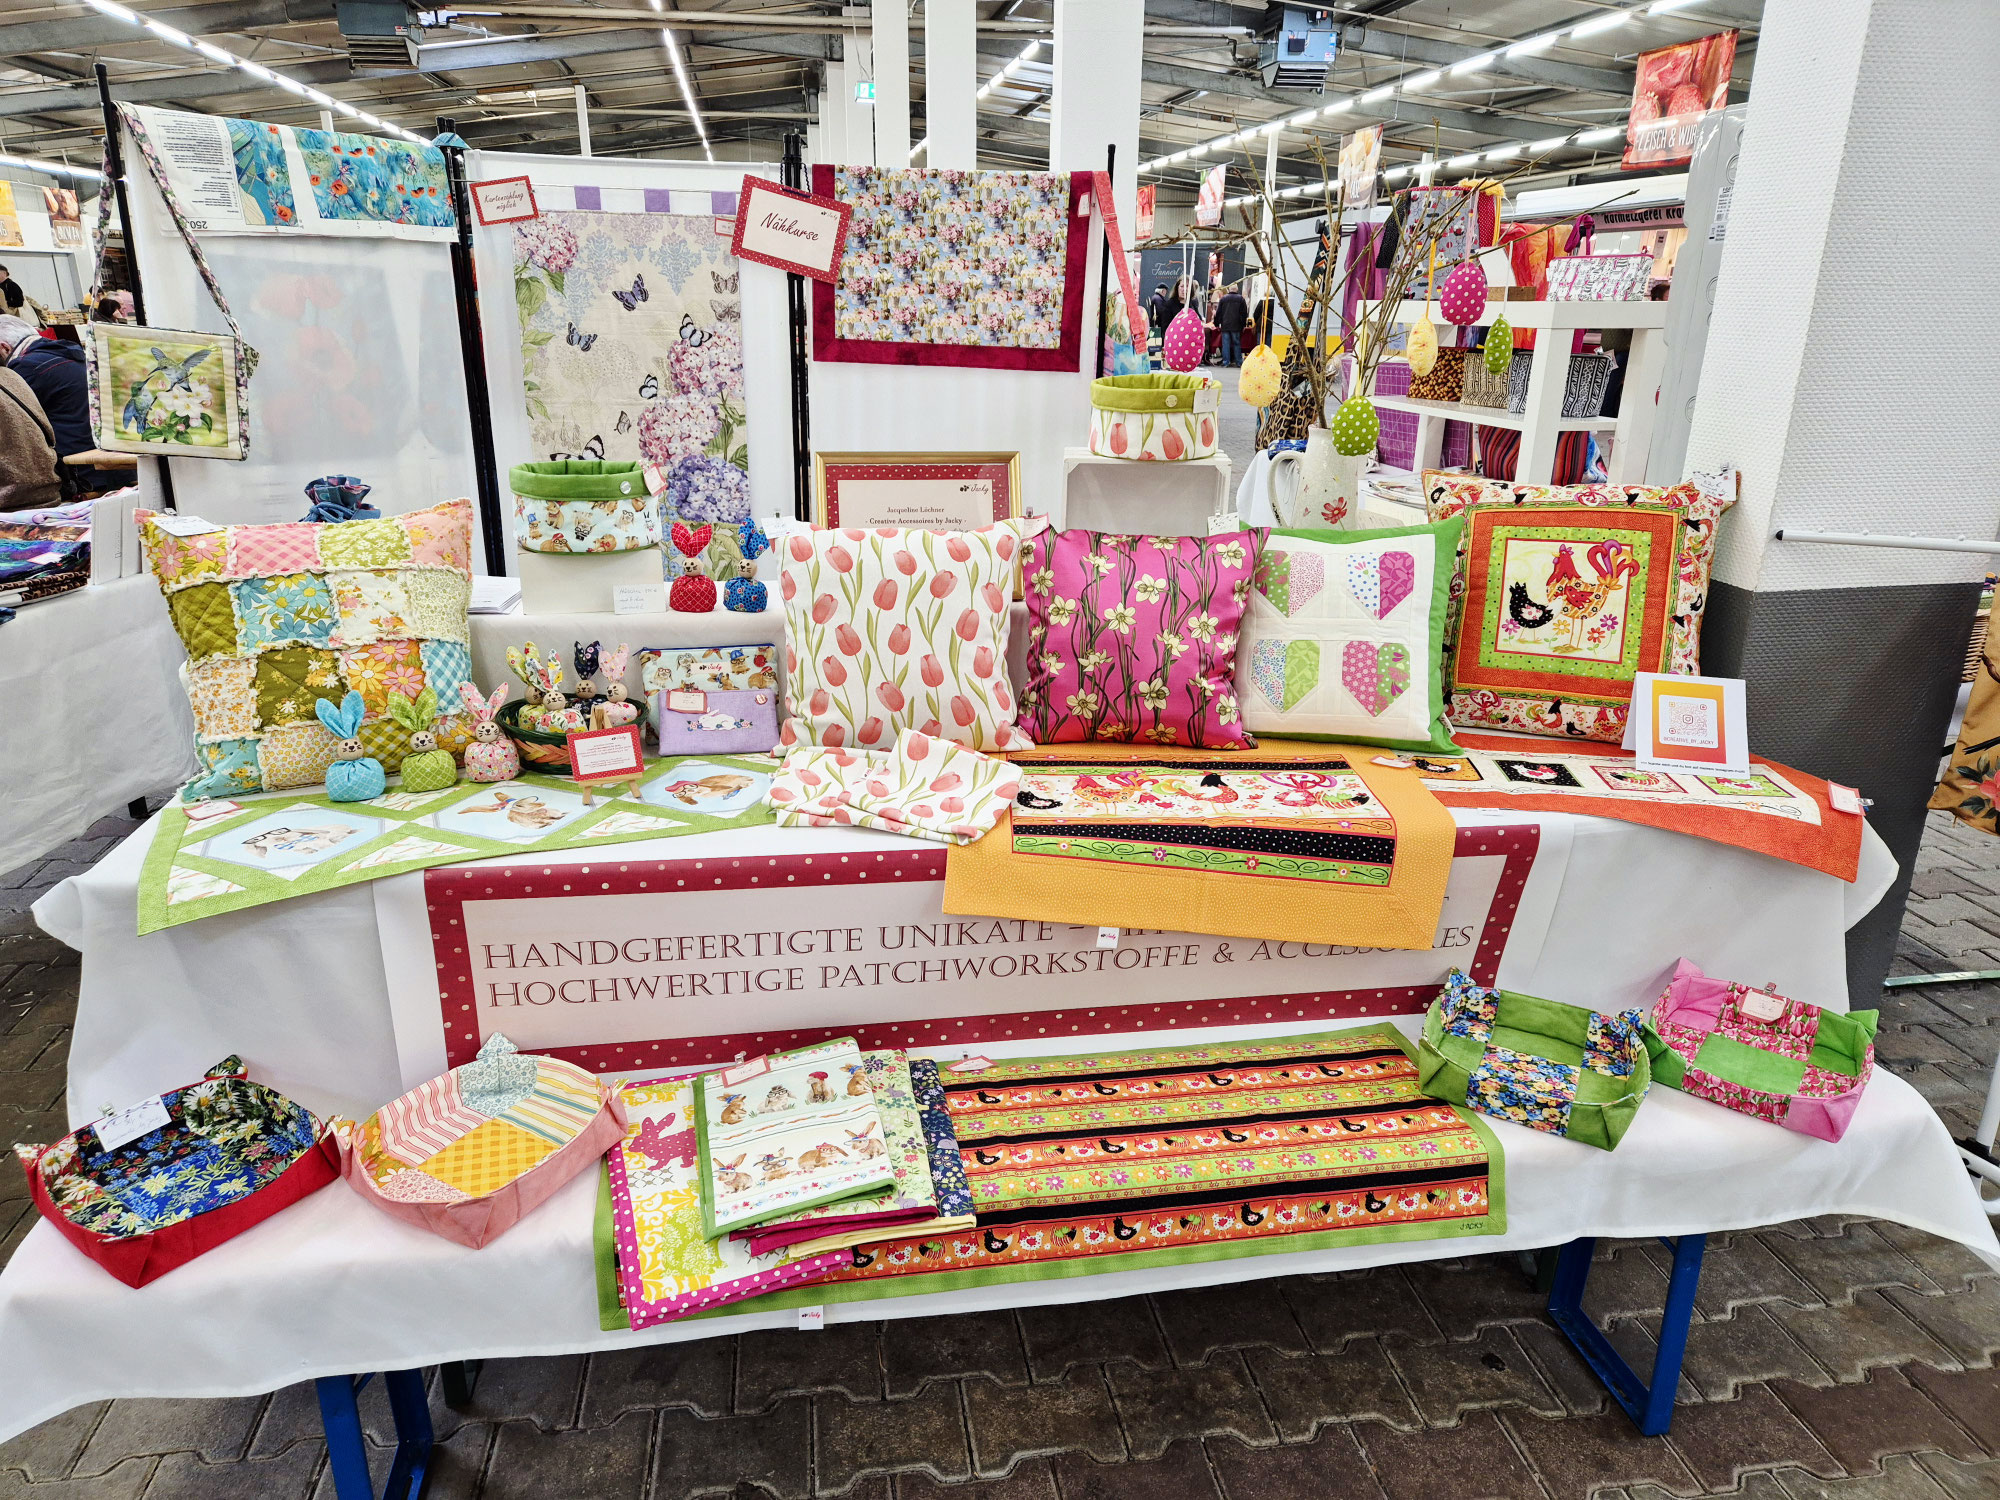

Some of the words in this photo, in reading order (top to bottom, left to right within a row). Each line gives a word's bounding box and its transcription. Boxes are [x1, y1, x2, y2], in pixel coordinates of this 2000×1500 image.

[1635, 128, 1667, 151] FLEISCH
[1678, 123, 1698, 146] WUR
[484, 191, 524, 203] Kartenzahlung
[496, 201, 517, 212] möglich
[760, 212, 819, 241] Nähkurse
[970, 483, 989, 494] Jacky
[886, 506, 919, 514] Jacqueline
[869, 517, 896, 525] Creative
[944, 517, 962, 525] Jacky
[707, 663, 723, 671] Jacky
[481, 928, 863, 969] HANDGEFERTIGTE
[877, 919, 1053, 950] UNIKATE
[489, 967, 804, 1007] HOCHWERTIGE
[818, 944, 1200, 989] PATCHWORKSTOFFE
[1212, 942, 1234, 963] &
